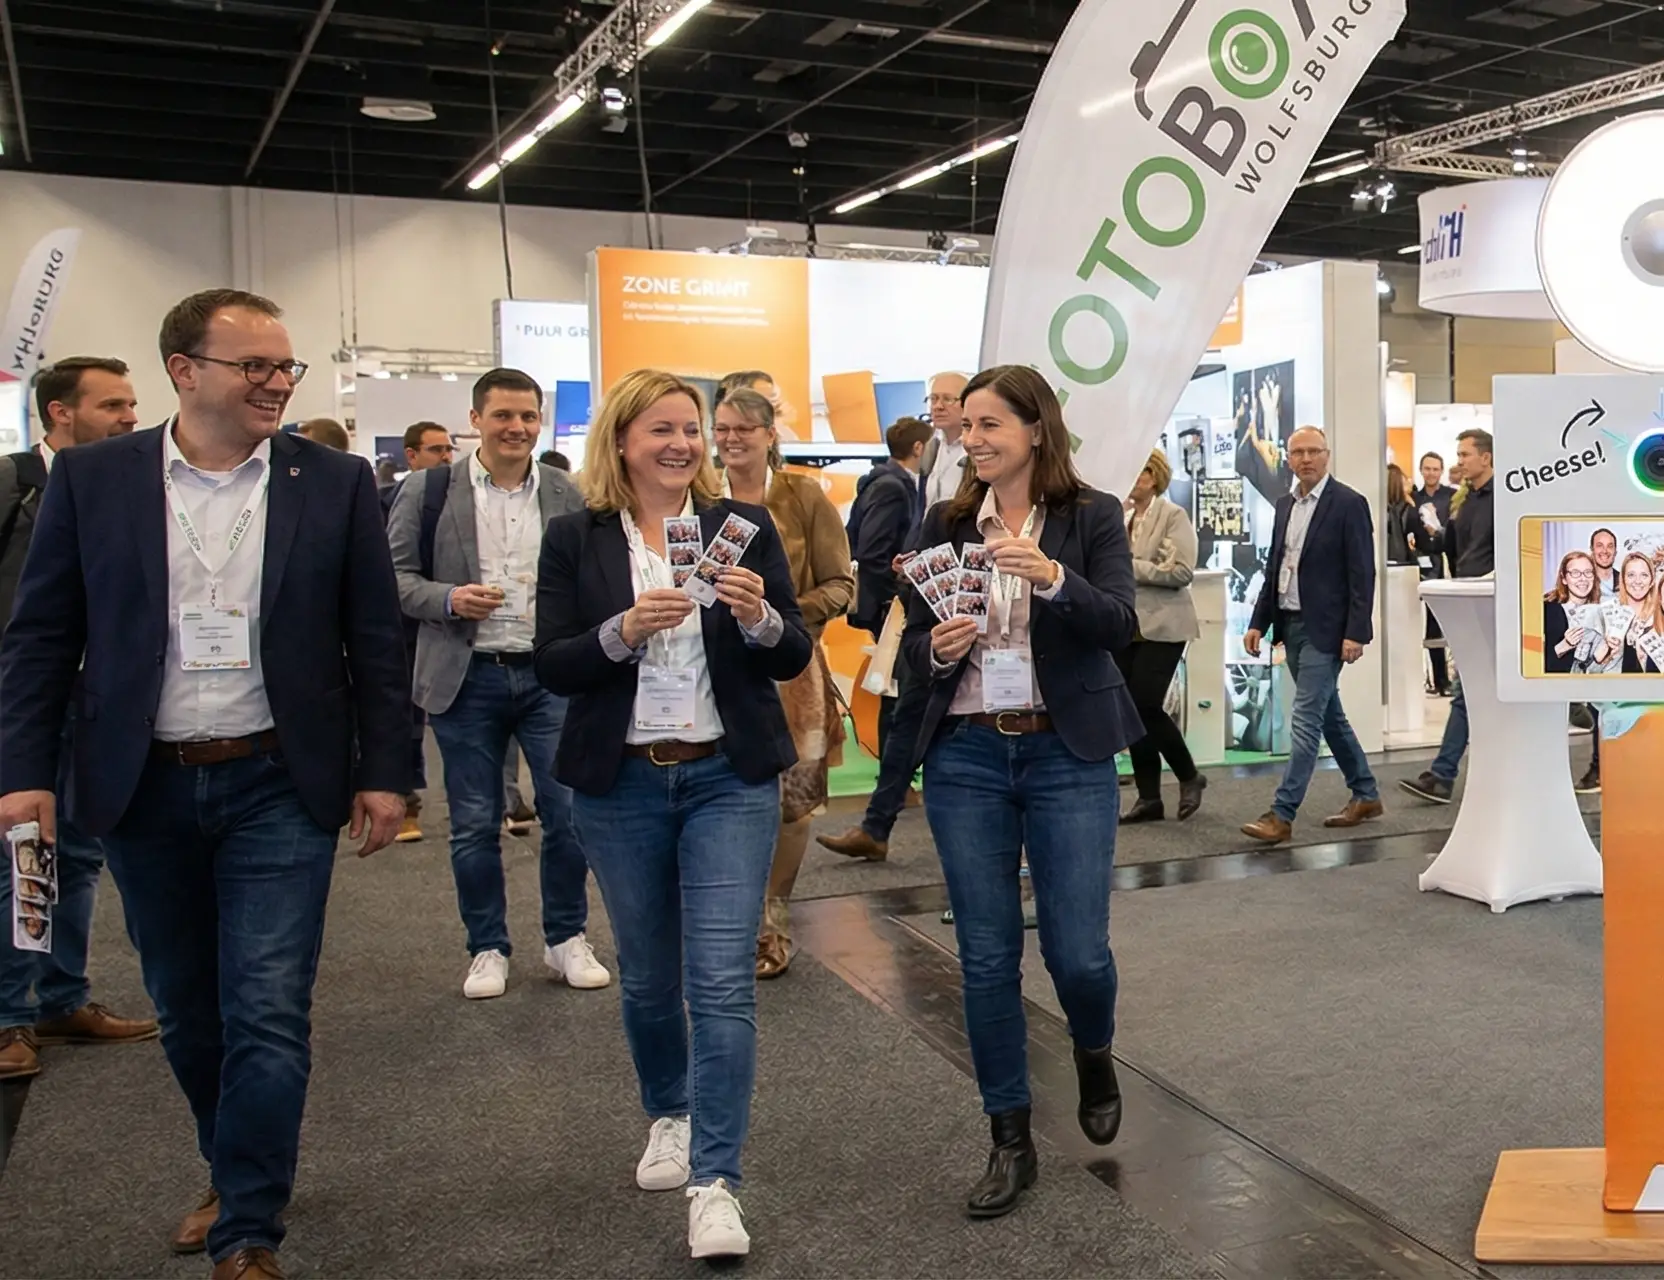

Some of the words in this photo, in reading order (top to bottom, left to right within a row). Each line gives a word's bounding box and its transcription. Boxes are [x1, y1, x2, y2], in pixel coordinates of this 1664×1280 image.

[1235, 0, 1373, 194] WOLFSBURG
[622, 276, 681, 294] ZONE
[1030, 0, 1316, 454] OTOBO
[1504, 440, 1606, 493] Cheese!
